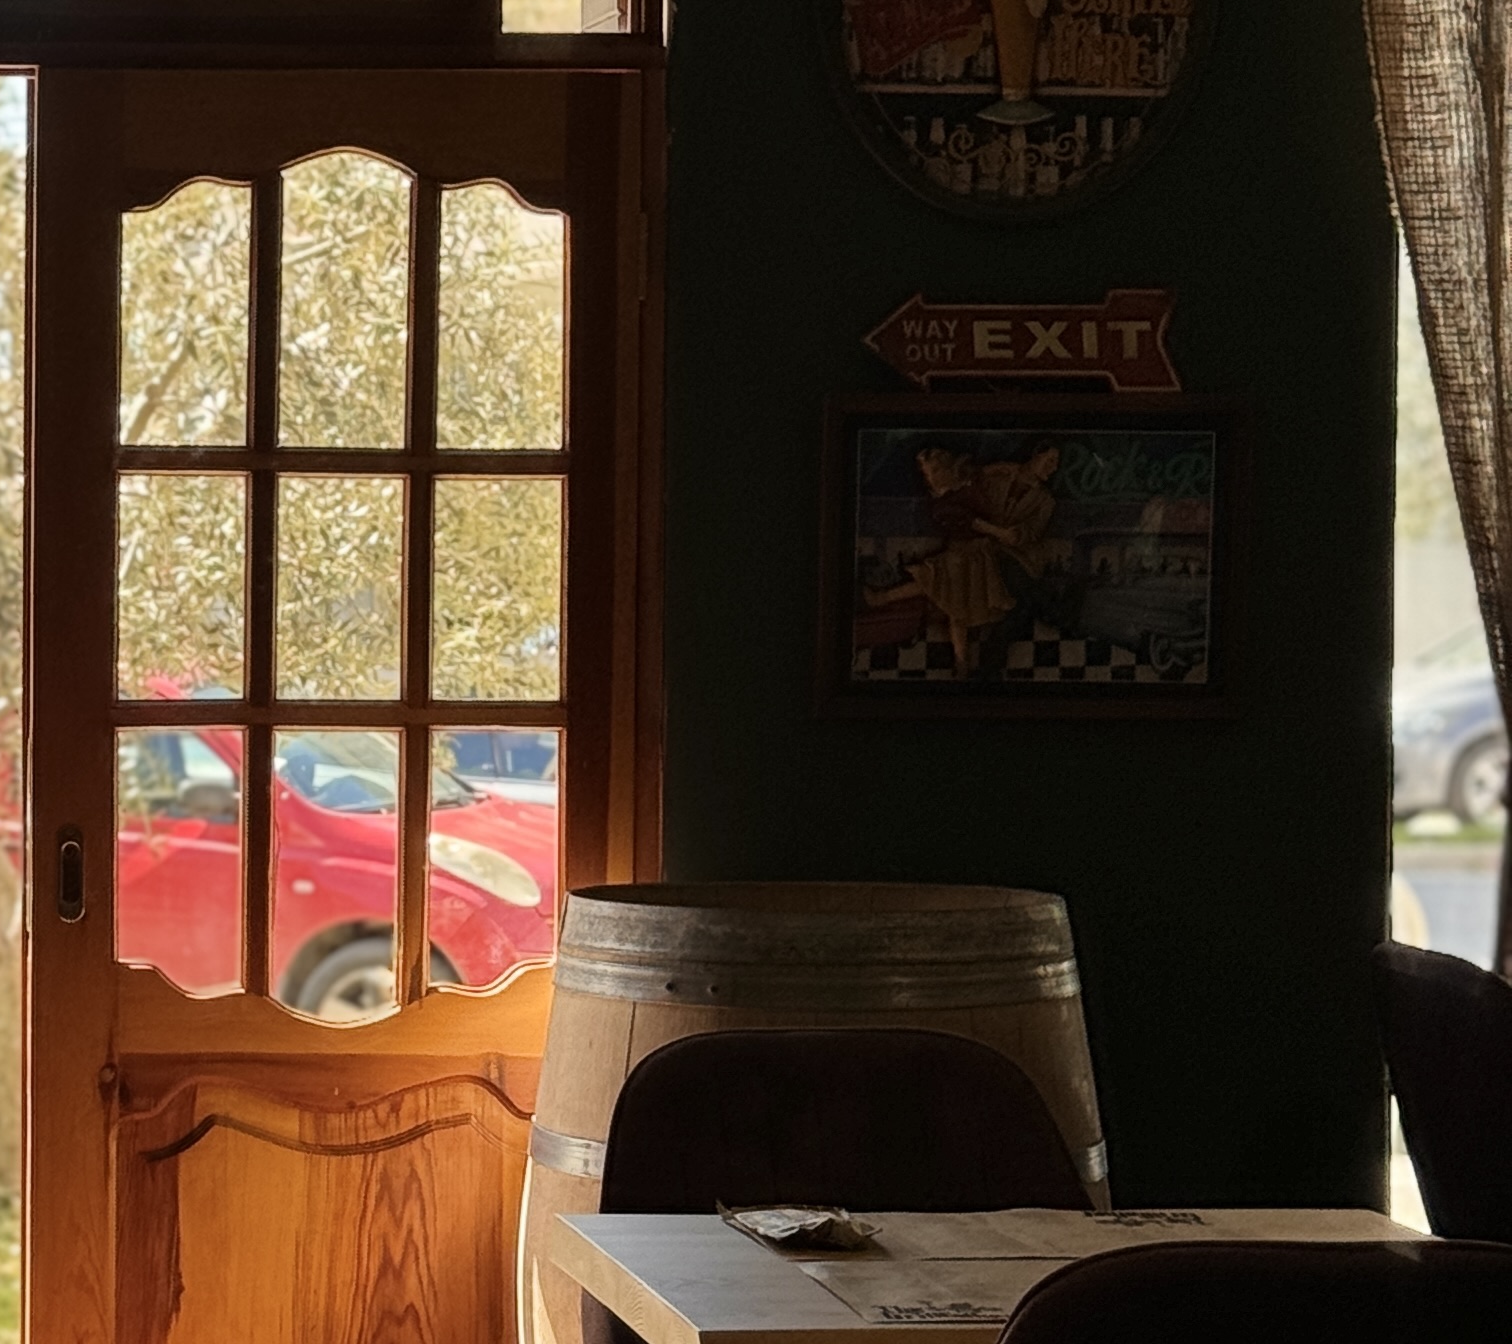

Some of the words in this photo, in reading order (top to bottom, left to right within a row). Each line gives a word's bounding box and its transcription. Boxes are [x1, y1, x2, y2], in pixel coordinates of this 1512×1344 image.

[902, 318, 958, 339] WAY
[971, 318, 1153, 359] EXIT
[905, 343, 957, 363] OUT
